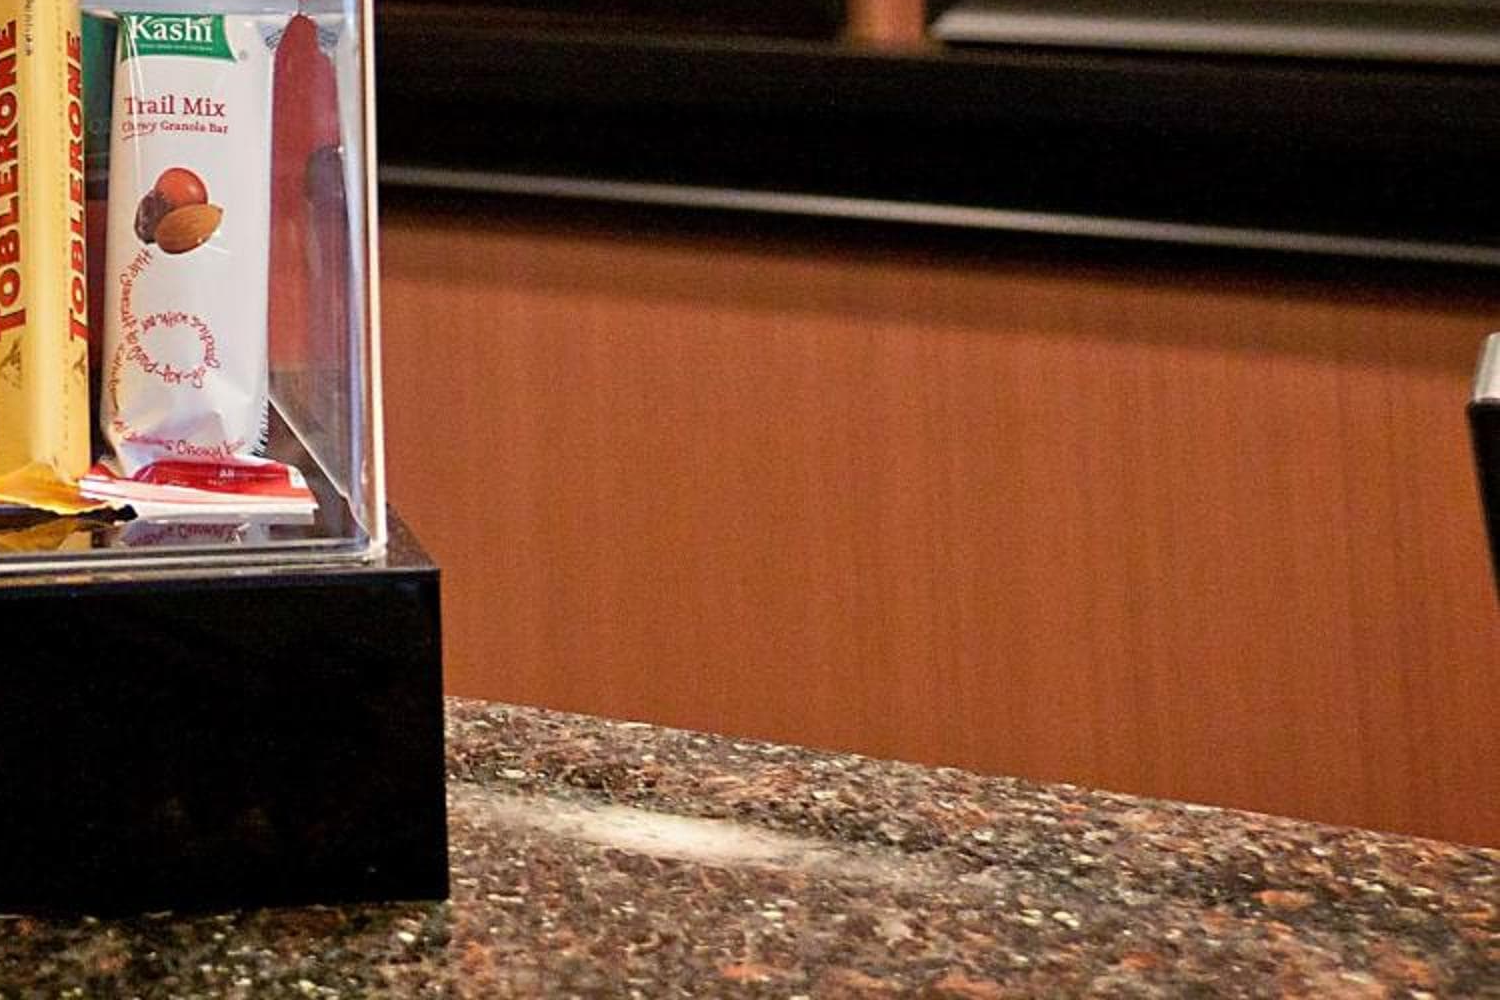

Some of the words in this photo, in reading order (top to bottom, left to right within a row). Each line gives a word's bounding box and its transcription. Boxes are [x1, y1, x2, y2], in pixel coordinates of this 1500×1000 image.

[129, 13, 214, 43] Kashi
[124, 94, 175, 117] Trail
[183, 96, 227, 118] Mix
[160, 120, 206, 134] Granola
[208, 122, 229, 135] Bar
[67, 29, 92, 342] TOBLERONE
